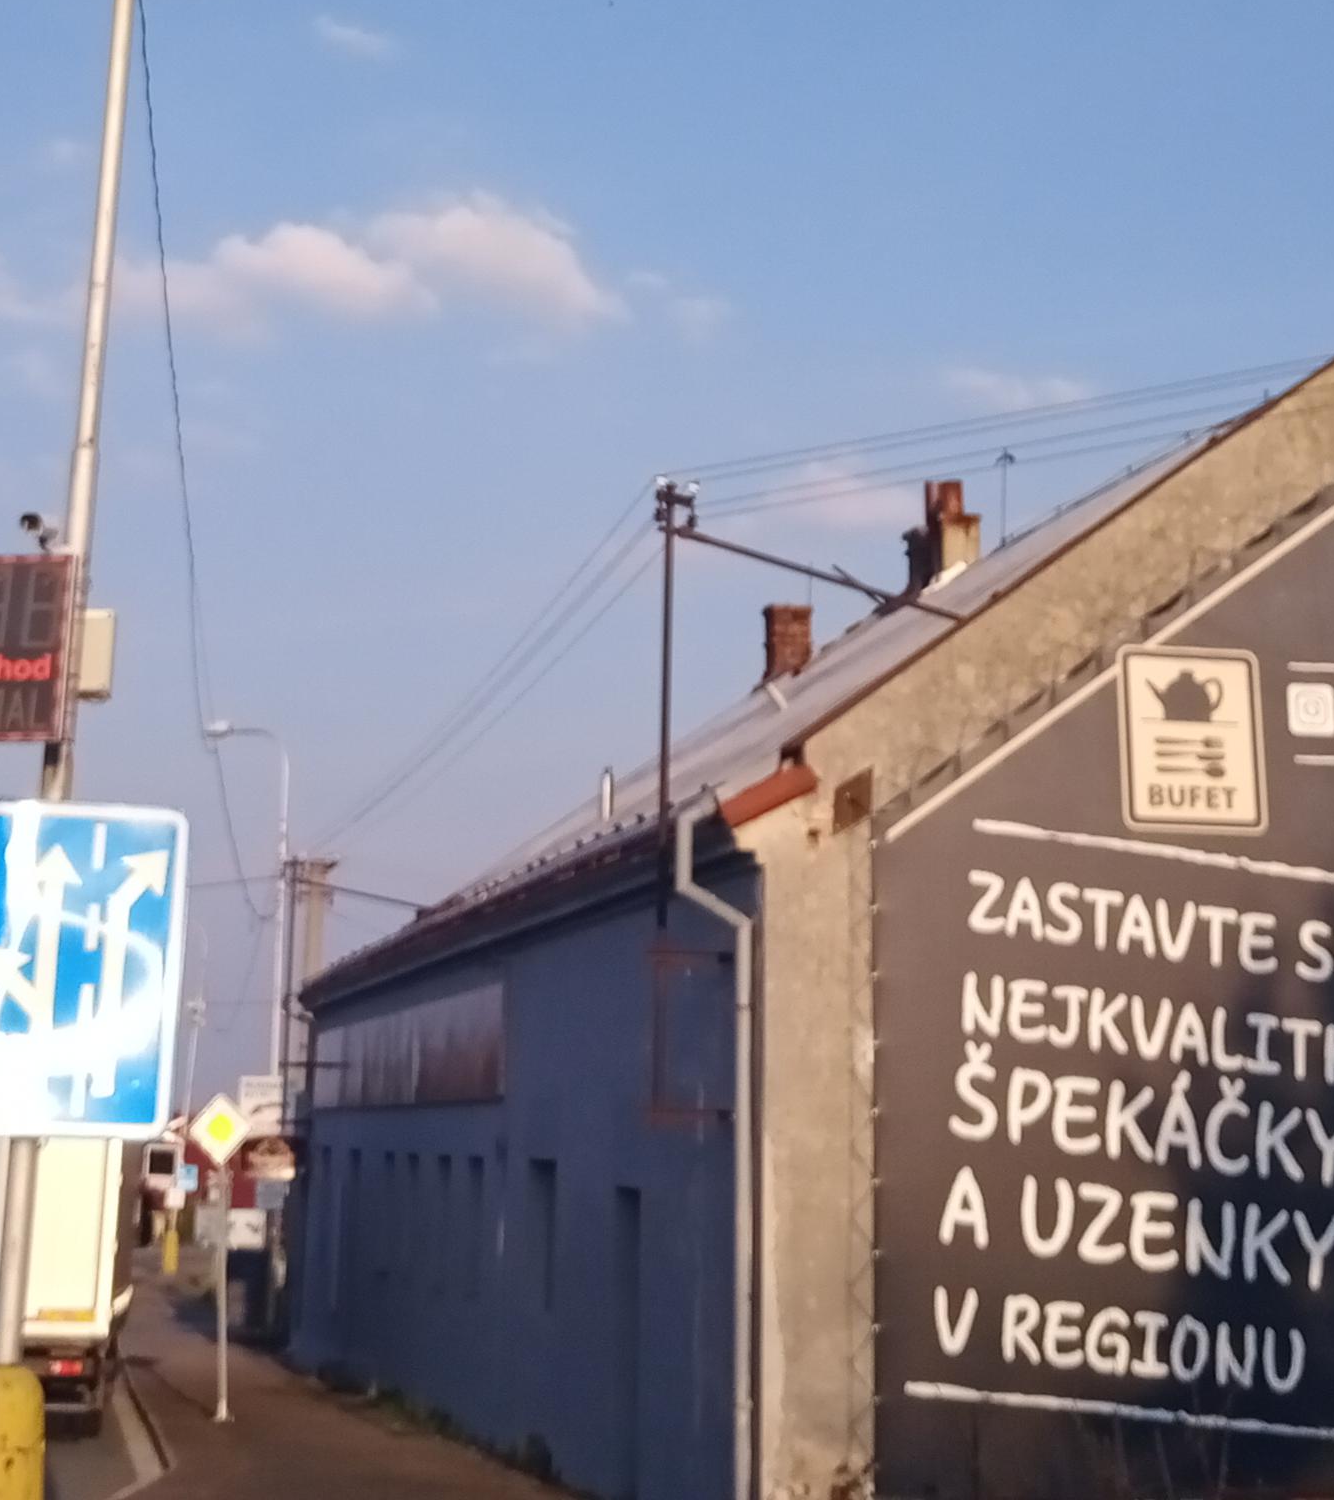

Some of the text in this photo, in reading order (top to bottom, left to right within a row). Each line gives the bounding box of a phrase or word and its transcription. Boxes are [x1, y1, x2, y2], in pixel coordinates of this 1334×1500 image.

[1148, 784, 1238, 810] BUFET
[968, 870, 1279, 975] ZASTAVTE
[939, 1166, 990, 1250] A
[934, 1286, 1306, 1392] V REGIONU
